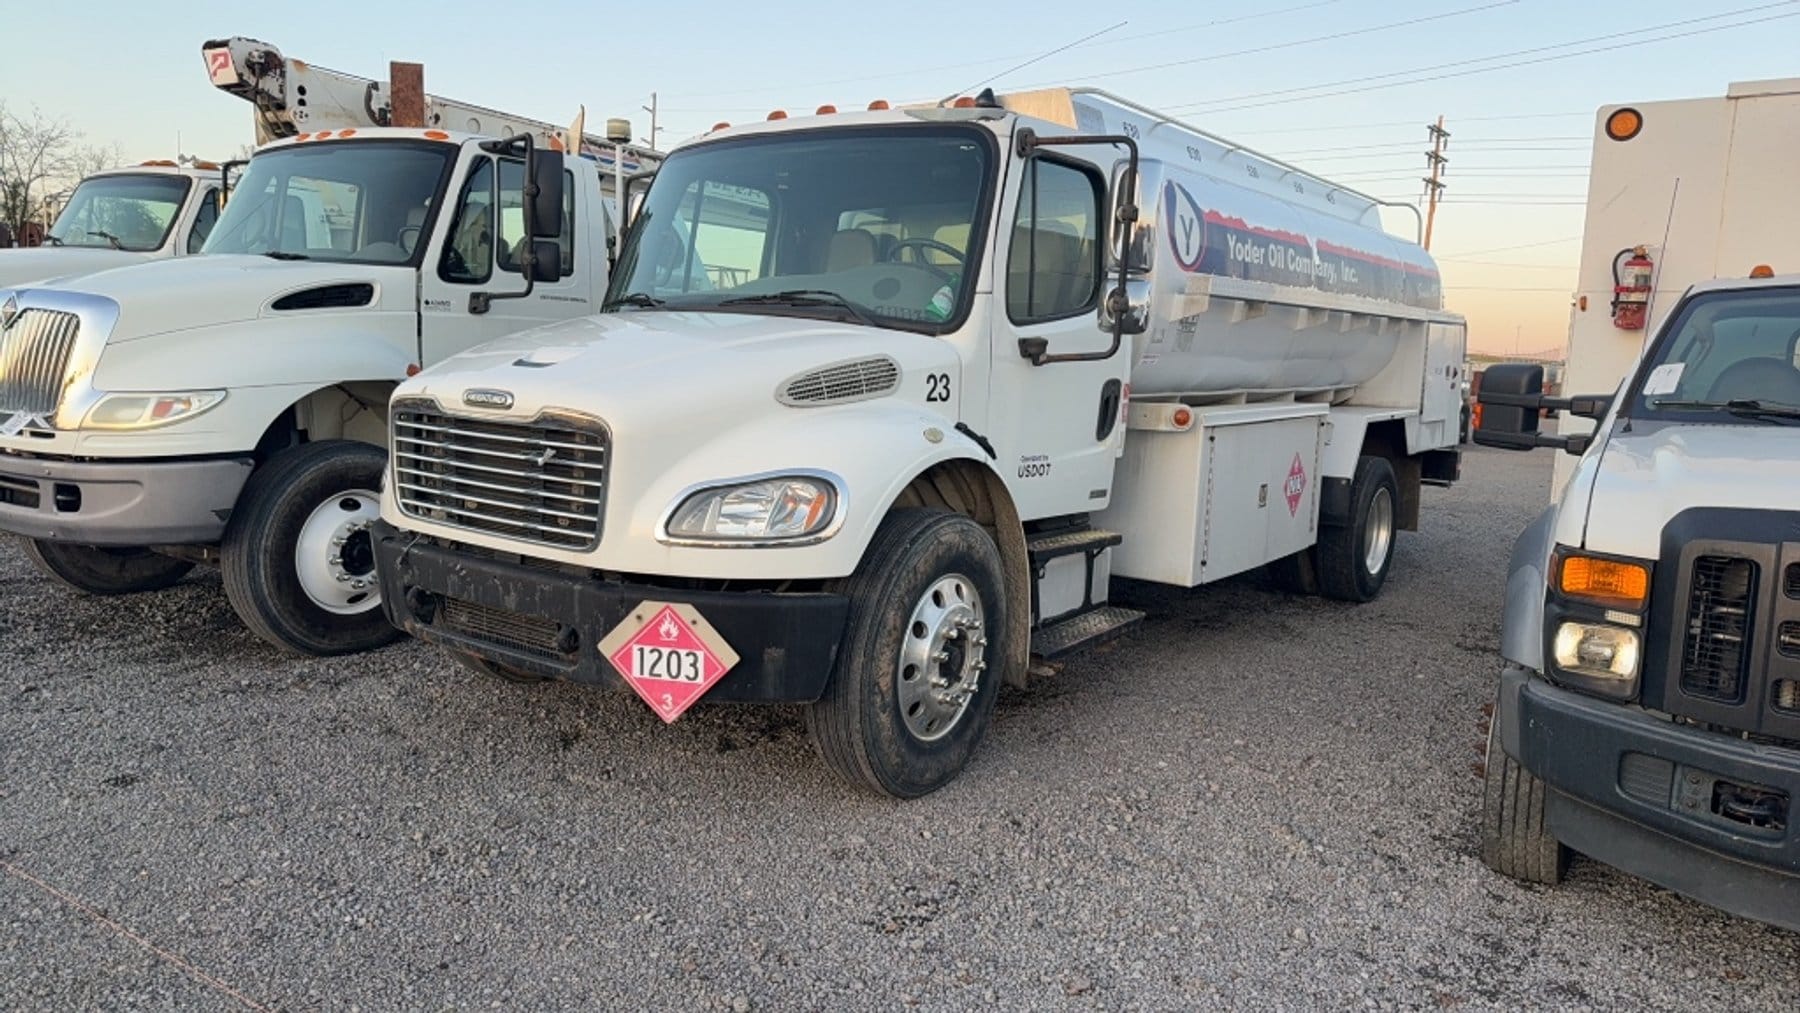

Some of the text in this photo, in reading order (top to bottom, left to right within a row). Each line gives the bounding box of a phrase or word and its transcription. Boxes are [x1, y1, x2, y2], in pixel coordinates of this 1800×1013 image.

[1180, 214, 1194, 256] Y
[1226, 233, 1265, 265] Yoder
[1268, 243, 1284, 269] Oil
[1341, 260, 1359, 282] Inc.
[926, 373, 950, 402] 23
[1017, 463, 1051, 478] USDOT
[637, 647, 699, 682] 1203
[661, 693, 673, 711] 3
